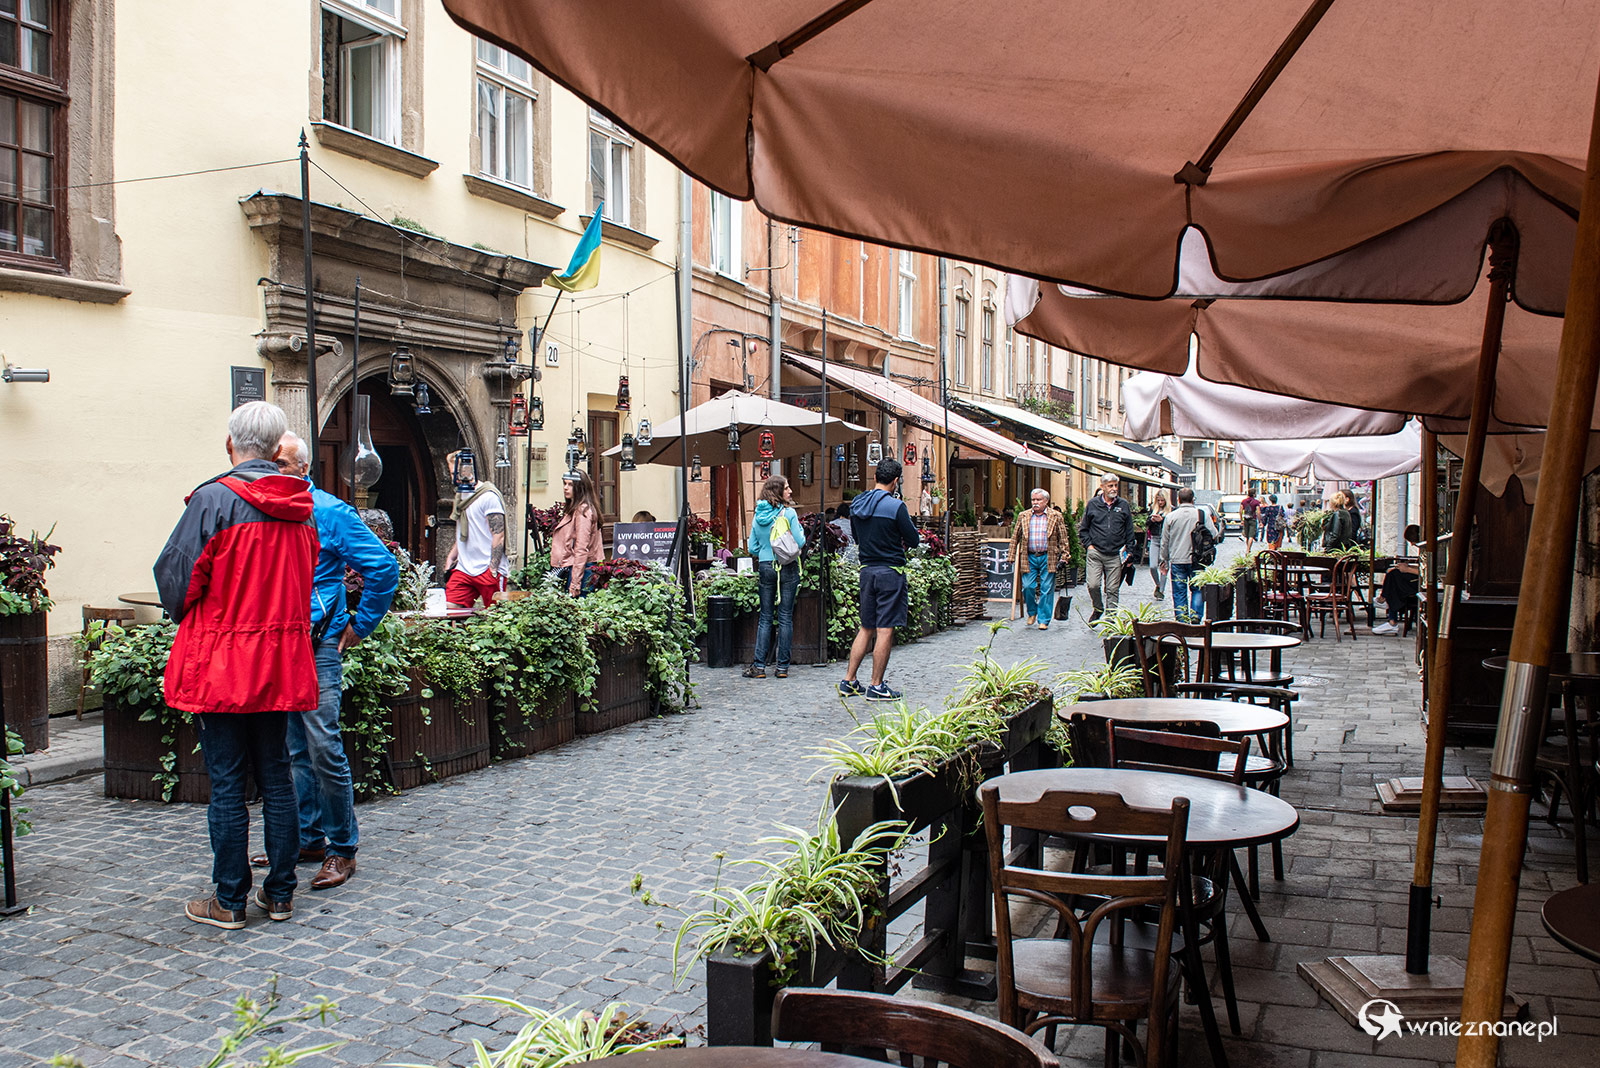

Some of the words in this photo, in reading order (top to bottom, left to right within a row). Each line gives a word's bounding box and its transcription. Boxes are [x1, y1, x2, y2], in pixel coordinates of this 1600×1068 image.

[548, 346, 558, 362] 20
[617, 532, 633, 540] LVIV
[632, 532, 653, 540] NIGHT
[981, 579, 1012, 593] eorgia
